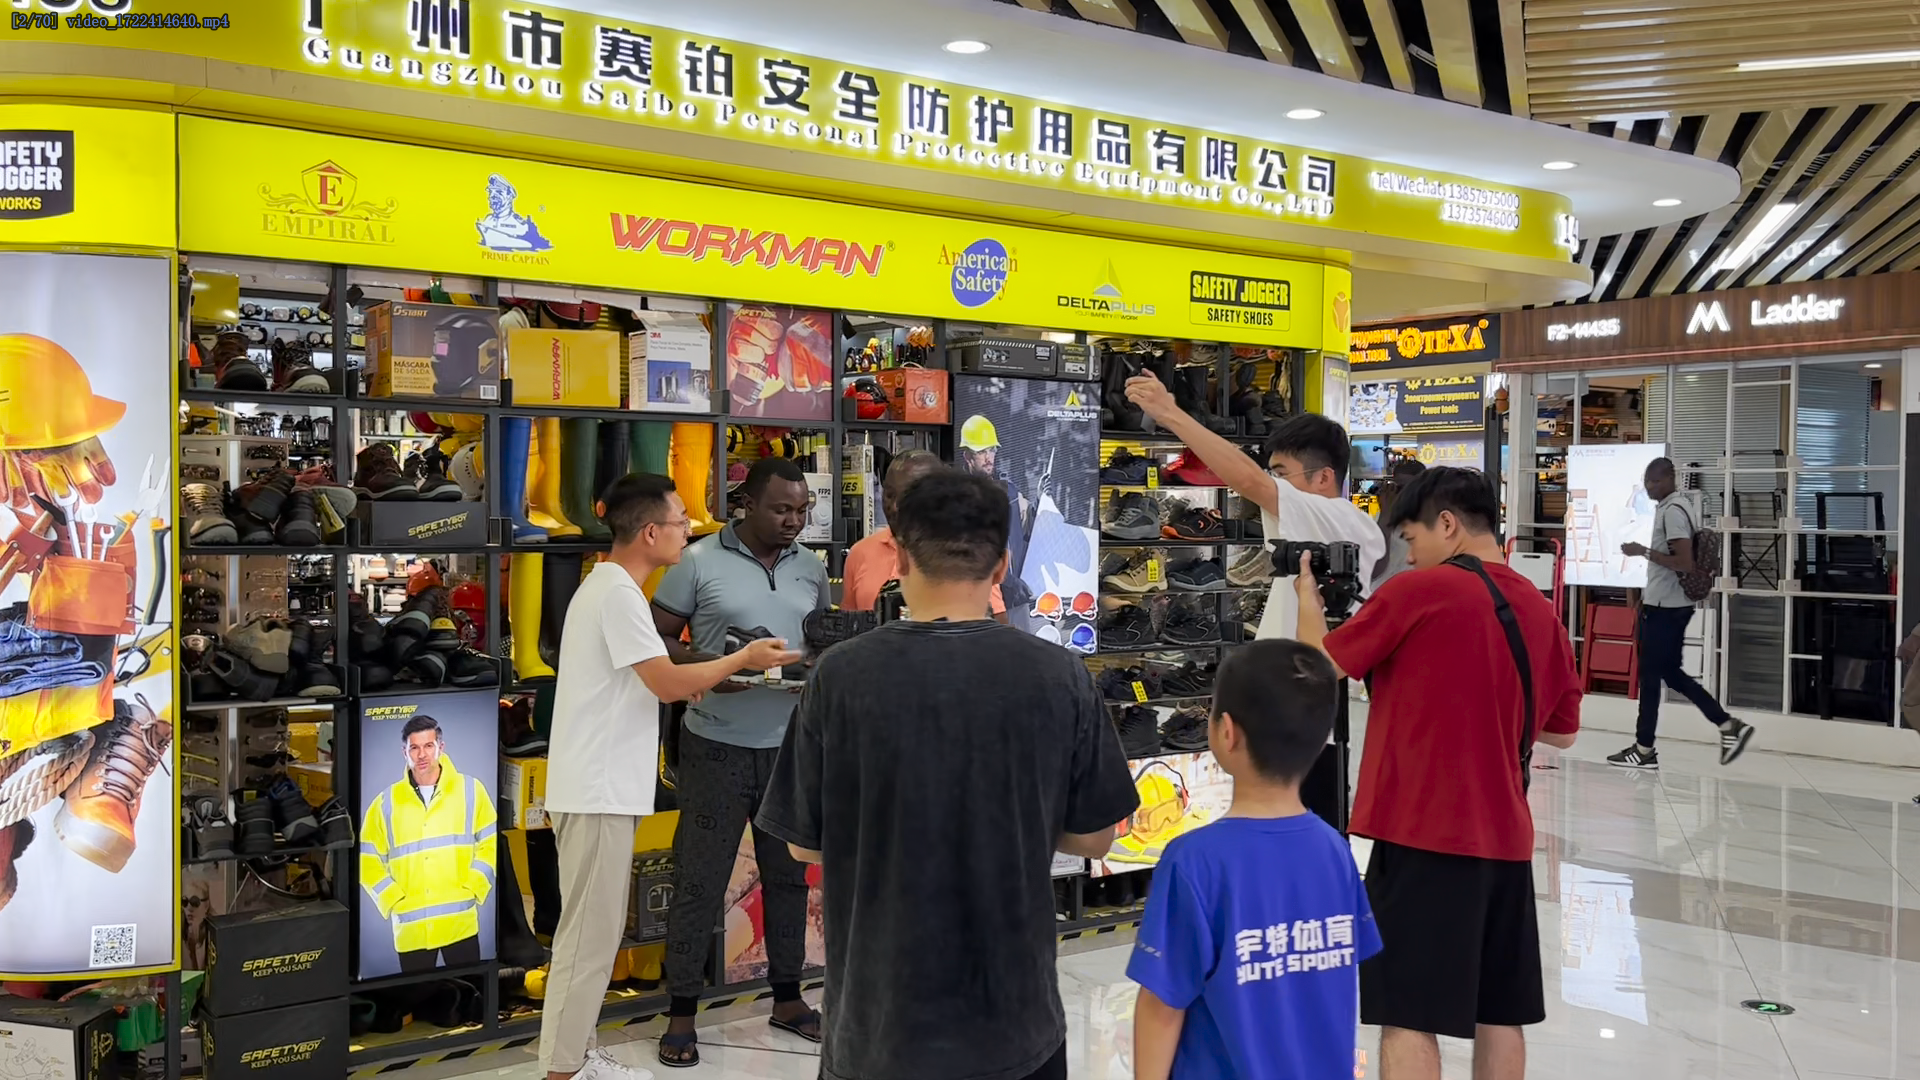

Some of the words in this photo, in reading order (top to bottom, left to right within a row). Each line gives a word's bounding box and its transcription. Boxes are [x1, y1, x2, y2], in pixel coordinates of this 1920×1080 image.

[304, 37, 562, 98] Guangzhou
[584, 82, 698, 118] Saibo
[717, 103, 878, 148] Personal
[896, 133, 1065, 176] Protective
[1078, 162, 1222, 200] Equipment
[1448, 183, 1520, 209] 13857975000
[261, 213, 396, 243] EMPIRAL
[1447, 204, 1520, 229] 13735746000
[481, 250, 510, 262] PRIME
[511, 254, 551, 265] CAPTAIN
[609, 212, 885, 277] WORKMAN
[937, 243, 1018, 272] American
[954, 267, 1008, 301] Safety
[1192, 274, 1238, 302] SAFETY
[1240, 279, 1289, 306] JOGGER
[1207, 307, 1241, 323] SAFETY
[1243, 310, 1273, 326] SHOES
[1750, 293, 1844, 326] Ladder
[394, 360, 430, 369] MÁSCARA
[552, 337, 562, 401] WORKMAN
[1047, 410, 1097, 419] DELTAPLUS
[1420, 406, 1441, 415] Power
[1441, 404, 1459, 414] tools
[818, 488, 832, 496] FFP2
[408, 511, 469, 537] SAFETYBOY
[417, 531, 433, 539] KEEP
[433, 527, 447, 535] YOU
[447, 523, 463, 531] SAFE
[365, 704, 418, 717] SAFETYBOY
[1235, 914, 1355, 962] 宇特体育
[242, 947, 326, 972] SAFETYBOY
[253, 968, 273, 978] KEEP
[273, 965, 292, 974] YOU
[292, 962, 312, 972] SAFE
[1236, 957, 1285, 985] YUTE
[1286, 947, 1355, 972] SPORT
[240, 1037, 325, 1063] SAFETYBOY
[251, 1060, 271, 1069] KEEP
[272, 1057, 291, 1065] YOU
[291, 1052, 312, 1063] SAFE
